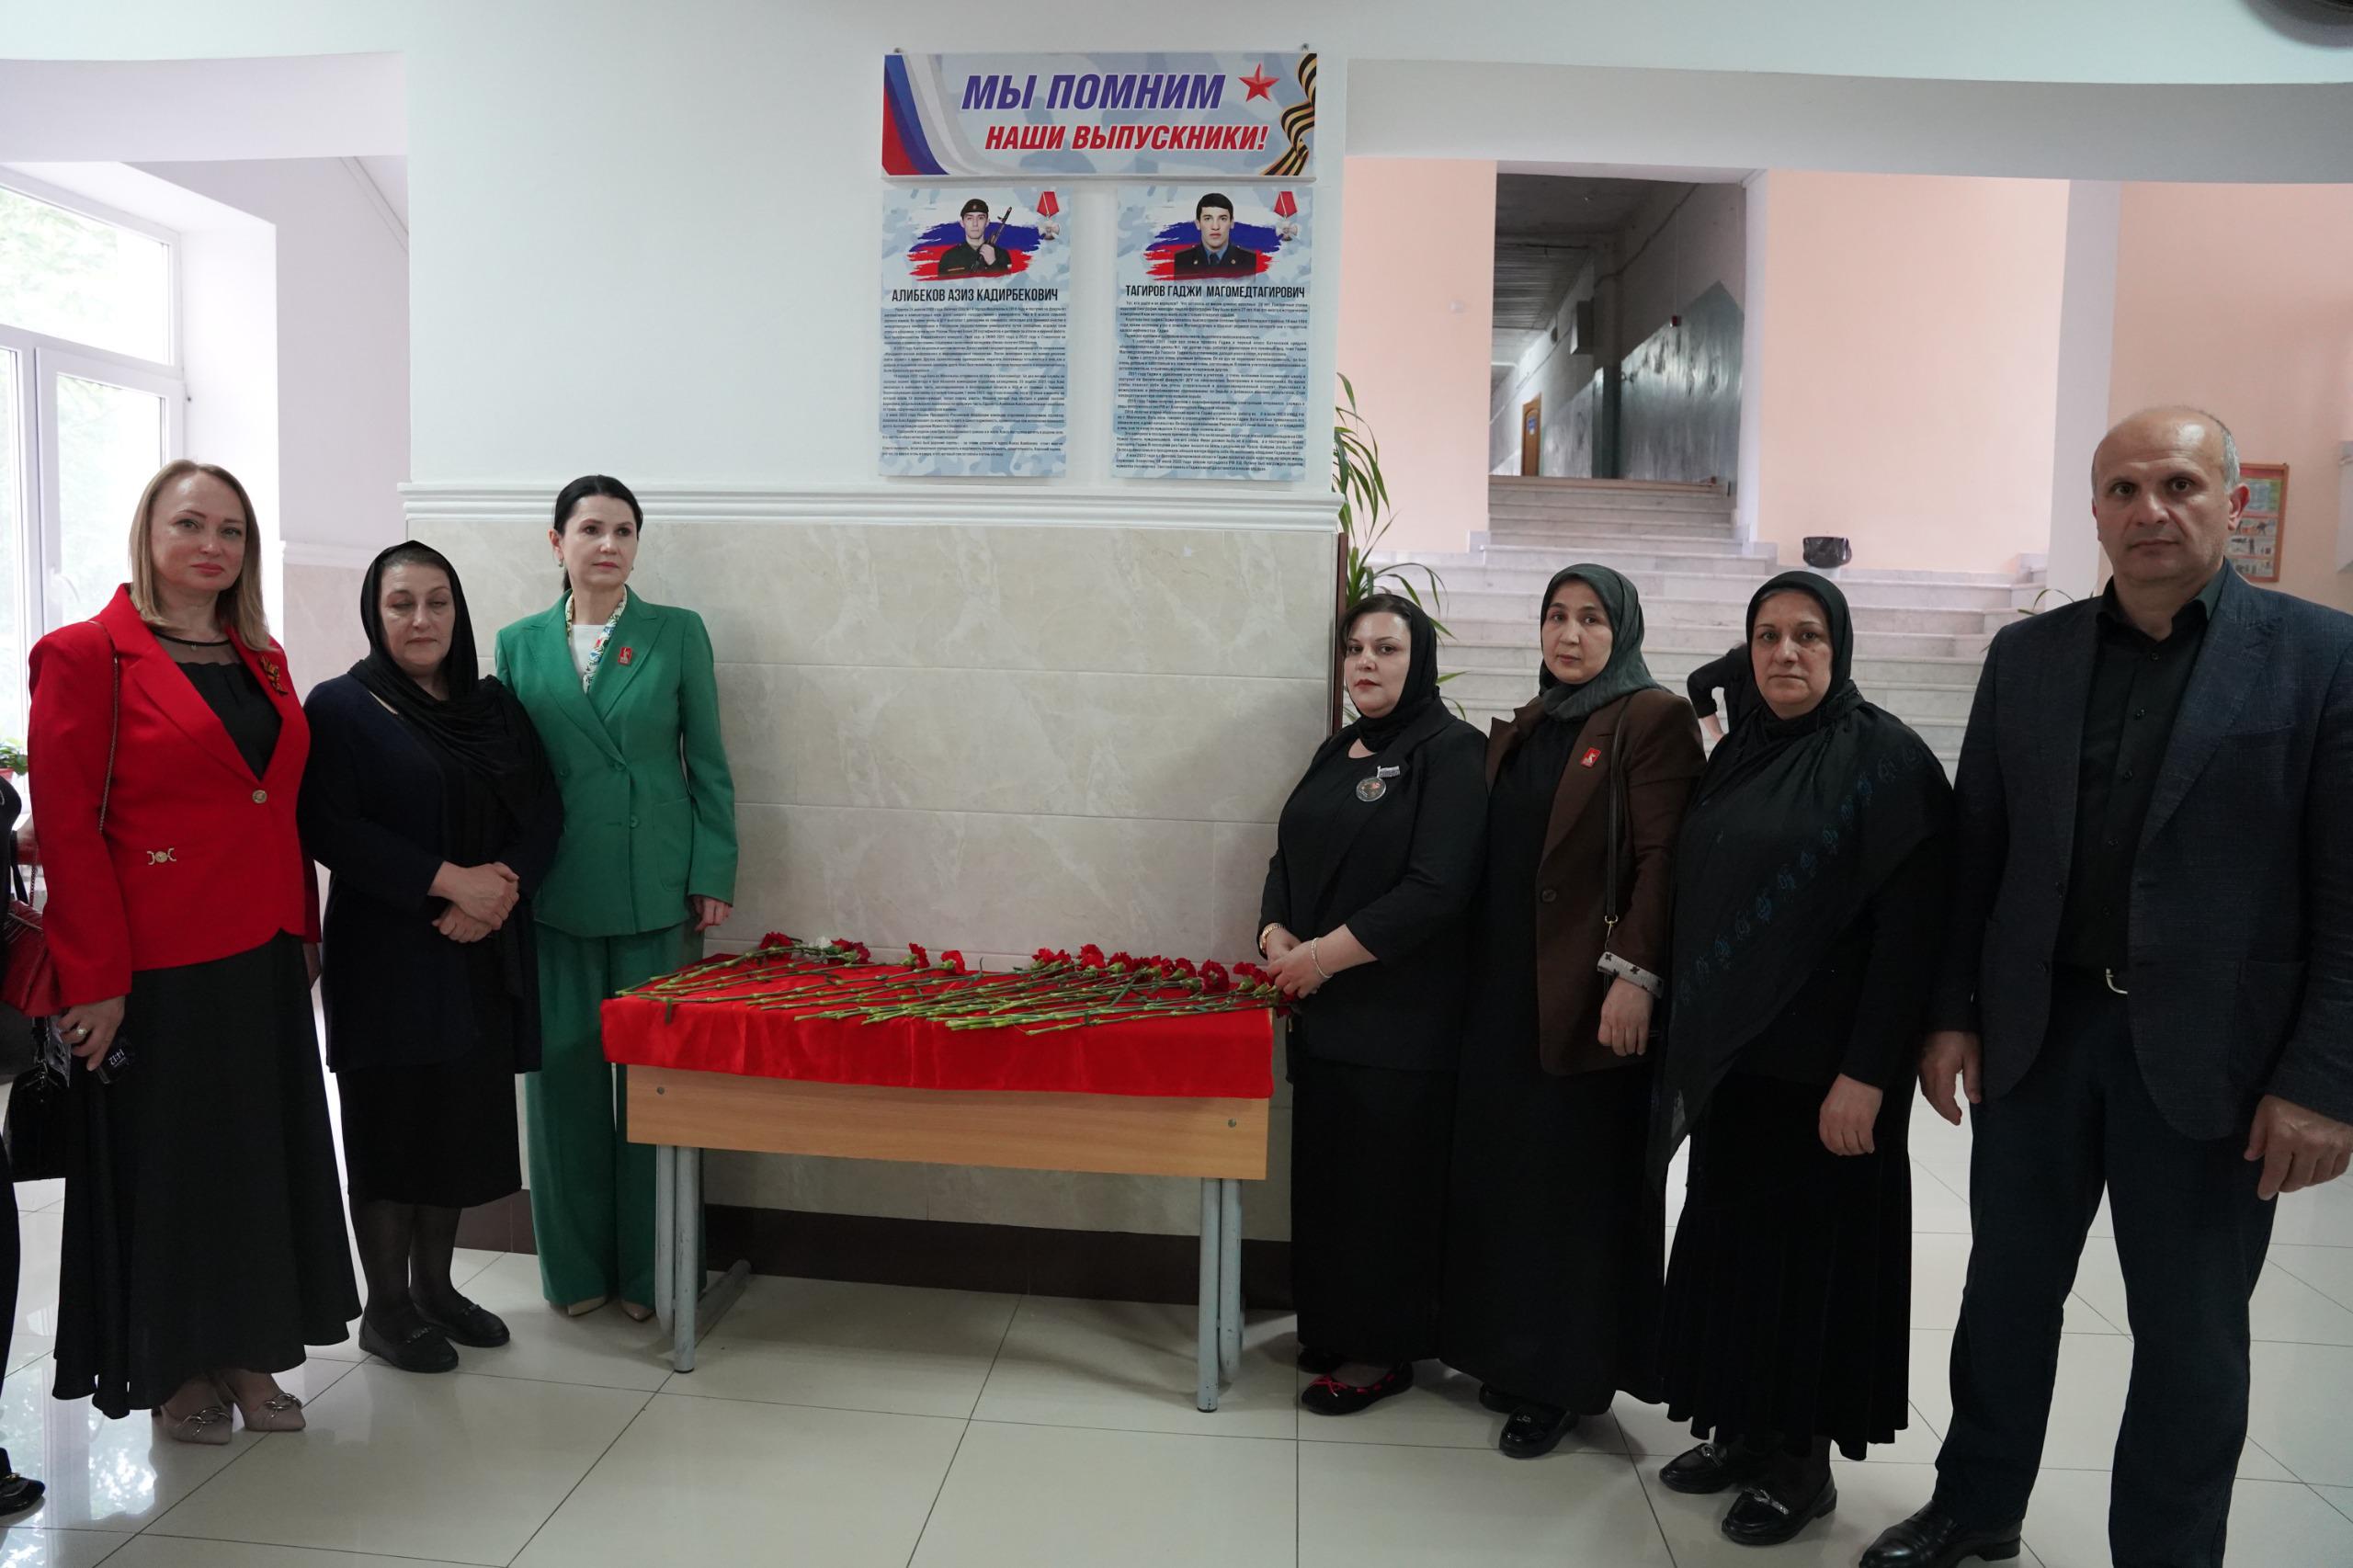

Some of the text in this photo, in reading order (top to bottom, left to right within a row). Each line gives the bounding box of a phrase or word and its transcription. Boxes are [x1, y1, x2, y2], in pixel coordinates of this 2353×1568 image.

[961, 74, 1226, 109] МЫ ПОМНИМ
[985, 125, 1268, 151] НАШИ ВЫПУСКНИКИ!
[892, 288, 1058, 302] АЛИБЕКОВ АЗИЗ КАДИРБЕКОВИЧ
[1126, 285, 1305, 299] ТАГИРОВ ГАДЖИ МАГОМЕДТАГИРОВИЧ
